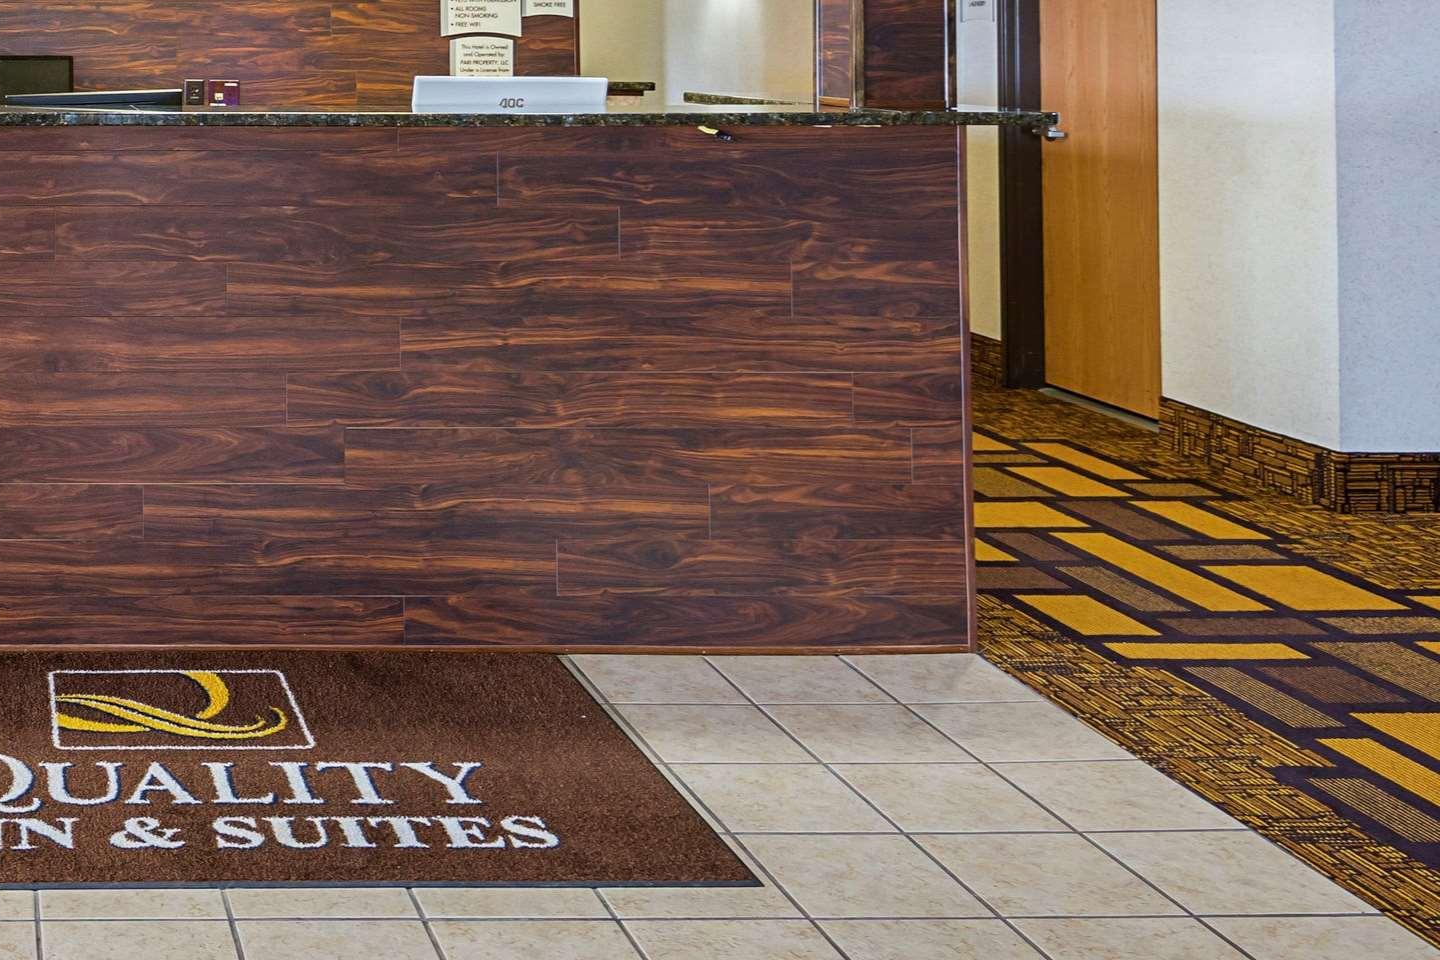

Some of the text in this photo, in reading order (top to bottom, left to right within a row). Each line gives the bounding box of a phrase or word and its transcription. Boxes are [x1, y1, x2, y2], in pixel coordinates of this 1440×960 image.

[498, 98, 525, 109] AOC
[109, 816, 188, 850] &
[211, 817, 560, 850] SUITES
